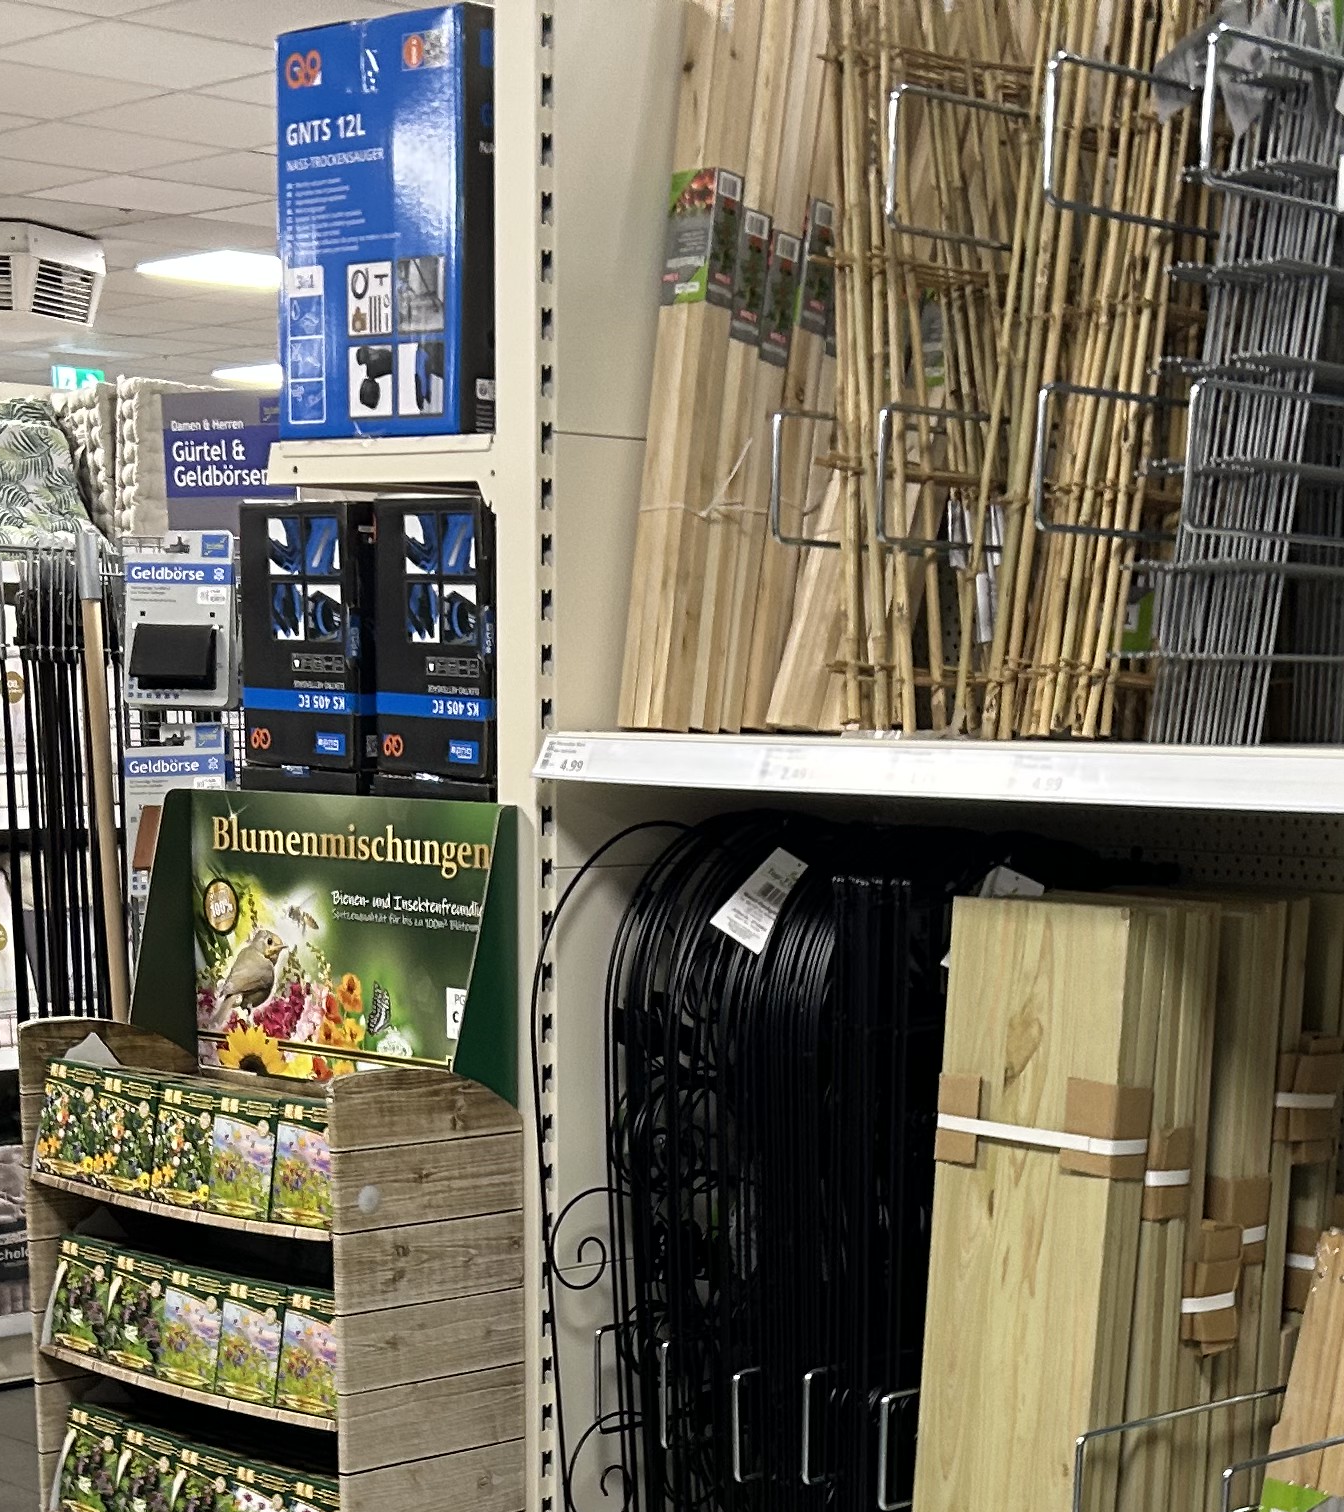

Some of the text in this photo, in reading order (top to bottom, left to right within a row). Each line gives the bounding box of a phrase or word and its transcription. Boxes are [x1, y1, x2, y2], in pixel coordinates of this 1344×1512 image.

[286, 113, 366, 146] GNTS 12L
[170, 420, 201, 432] Damen
[212, 419, 244, 430] Herren
[172, 439, 246, 462] Gürtel &
[131, 566, 205, 581] Geldbörse
[298, 694, 345, 711] KS 405 EC
[432, 699, 480, 717] KS 405 EC
[129, 758, 200, 774] Geldbörse
[558, 759, 584, 774] 4.99
[212, 814, 490, 878] Blumenmischungen
[331, 889, 370, 906] Bienen-
[371, 892, 391, 909] und
